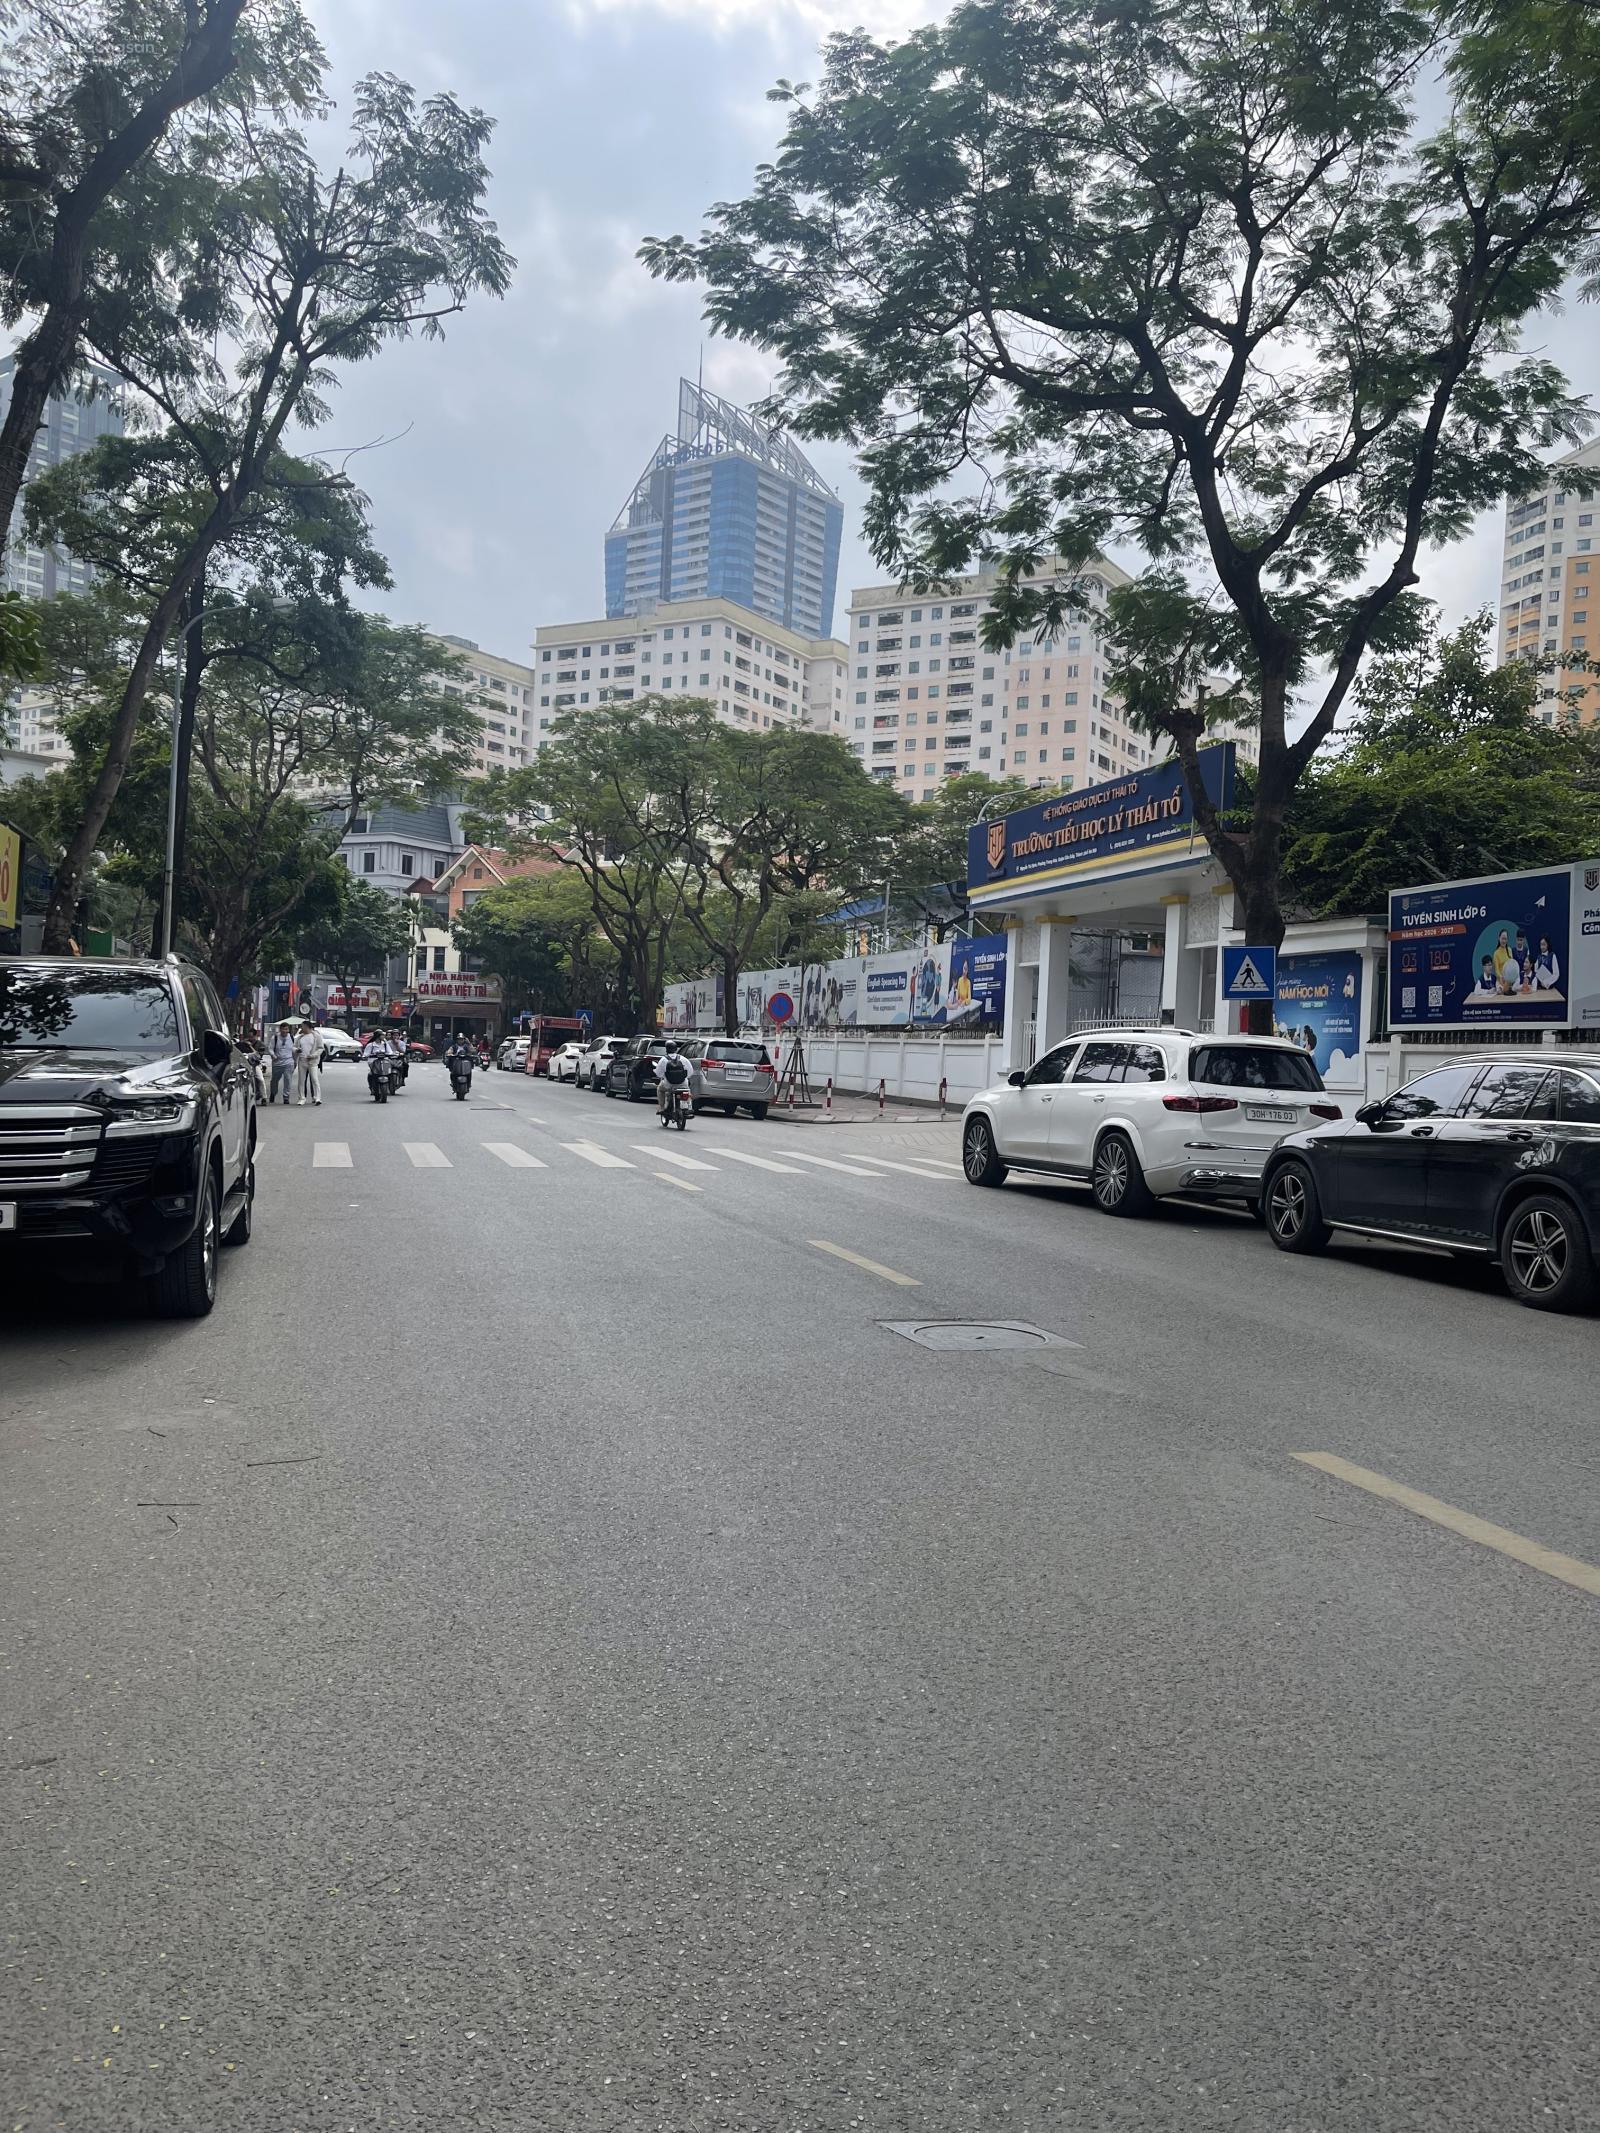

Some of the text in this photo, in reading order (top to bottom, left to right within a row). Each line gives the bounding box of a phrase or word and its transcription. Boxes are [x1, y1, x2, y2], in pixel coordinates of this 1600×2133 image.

[1072, 796, 1088, 812] GIÁO
[1012, 785, 1183, 857] TRƯỜNG TIỂU HỌC LÝ THÁI TỔ
[1434, 909, 1457, 923] SINH
[1459, 904, 1478, 920] LỚP
[1479, 906, 1487, 917] 6
[1428, 950, 1451, 965] 180
